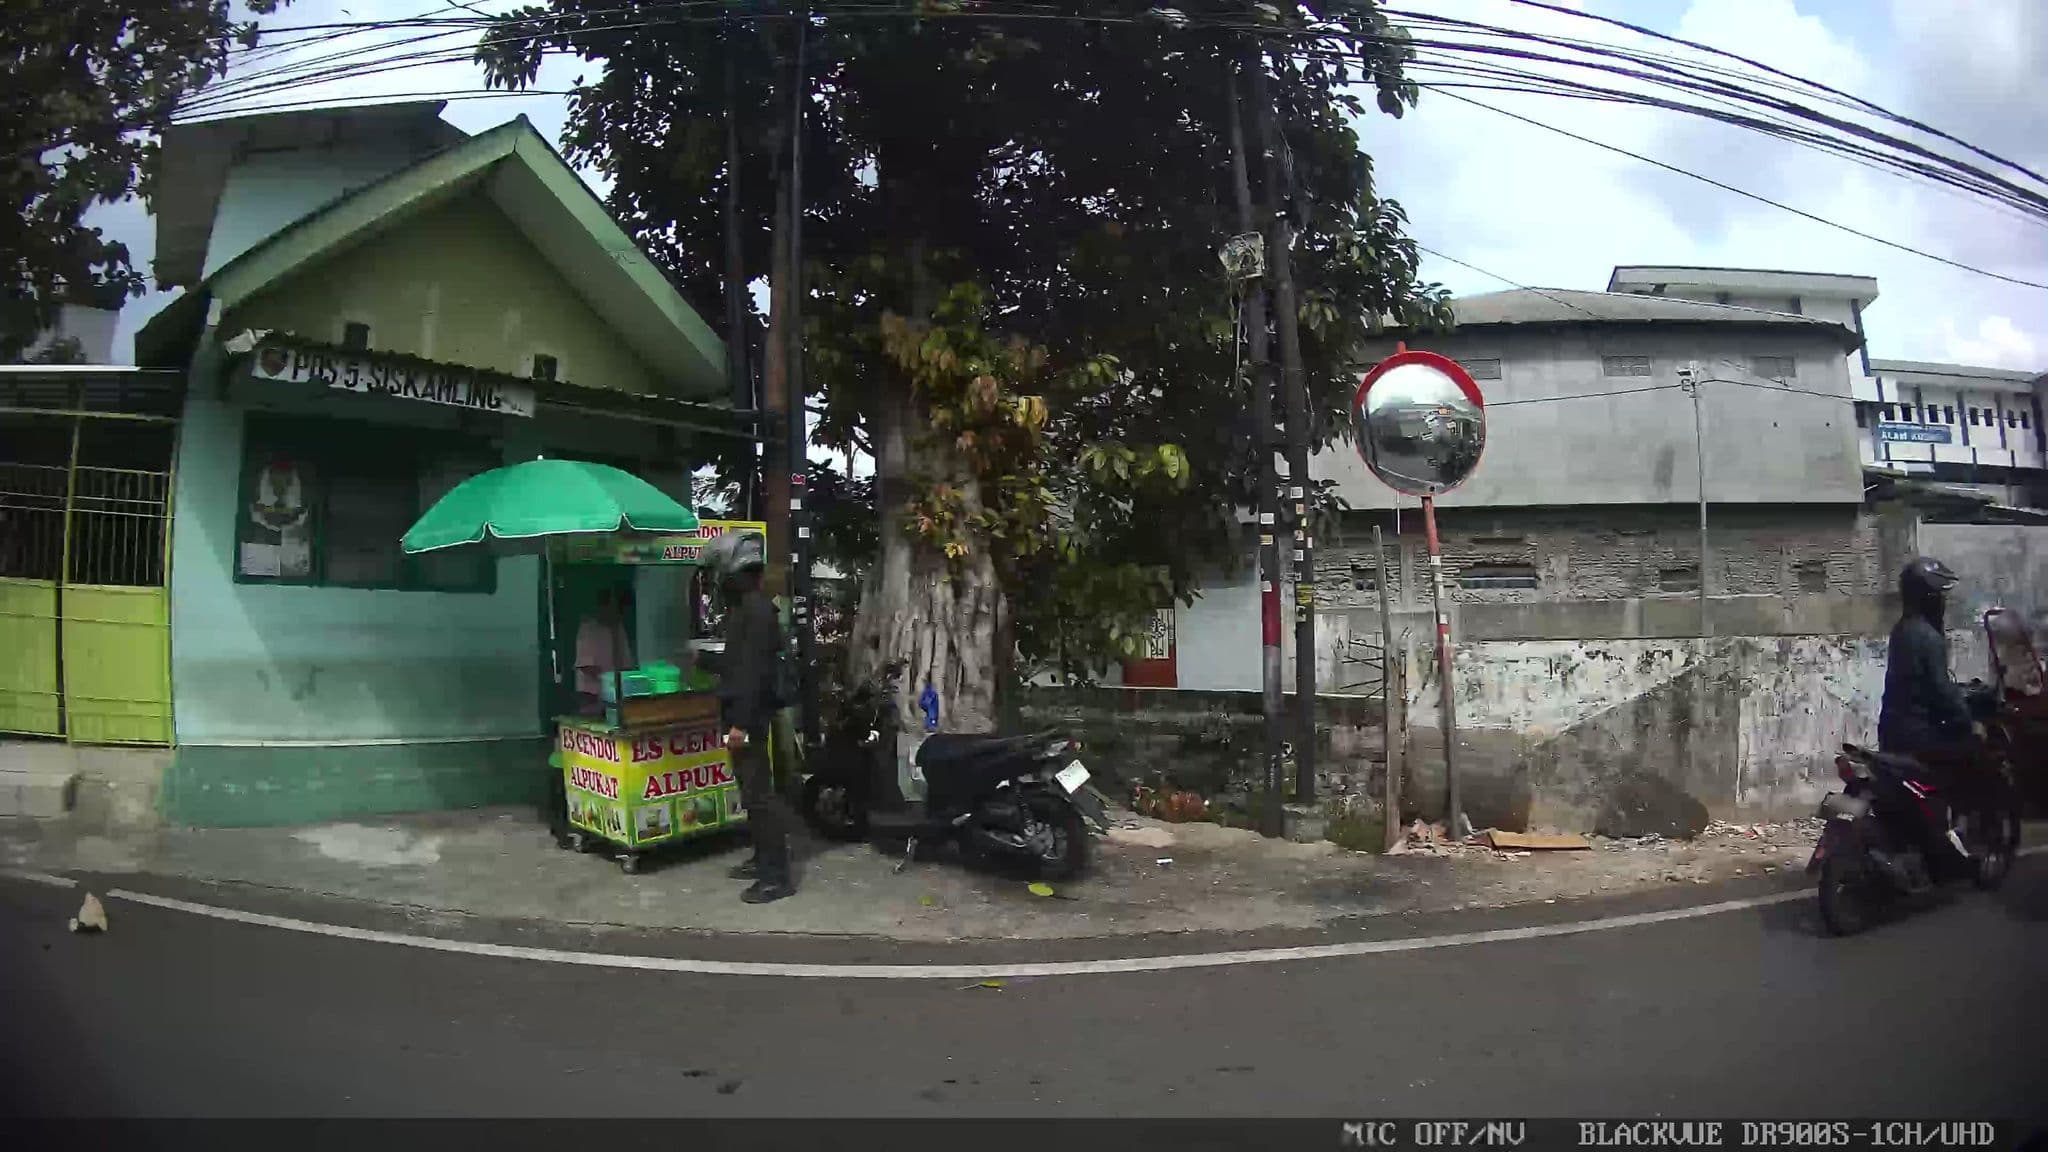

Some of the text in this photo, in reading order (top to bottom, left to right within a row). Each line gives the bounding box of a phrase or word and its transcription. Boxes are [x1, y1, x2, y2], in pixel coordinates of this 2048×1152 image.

[563, 729, 620, 762] ES CENDOL
[632, 735, 664, 762] ES
[571, 767, 619, 799] ALPUKAT
[644, 763, 734, 798] ALPUK
